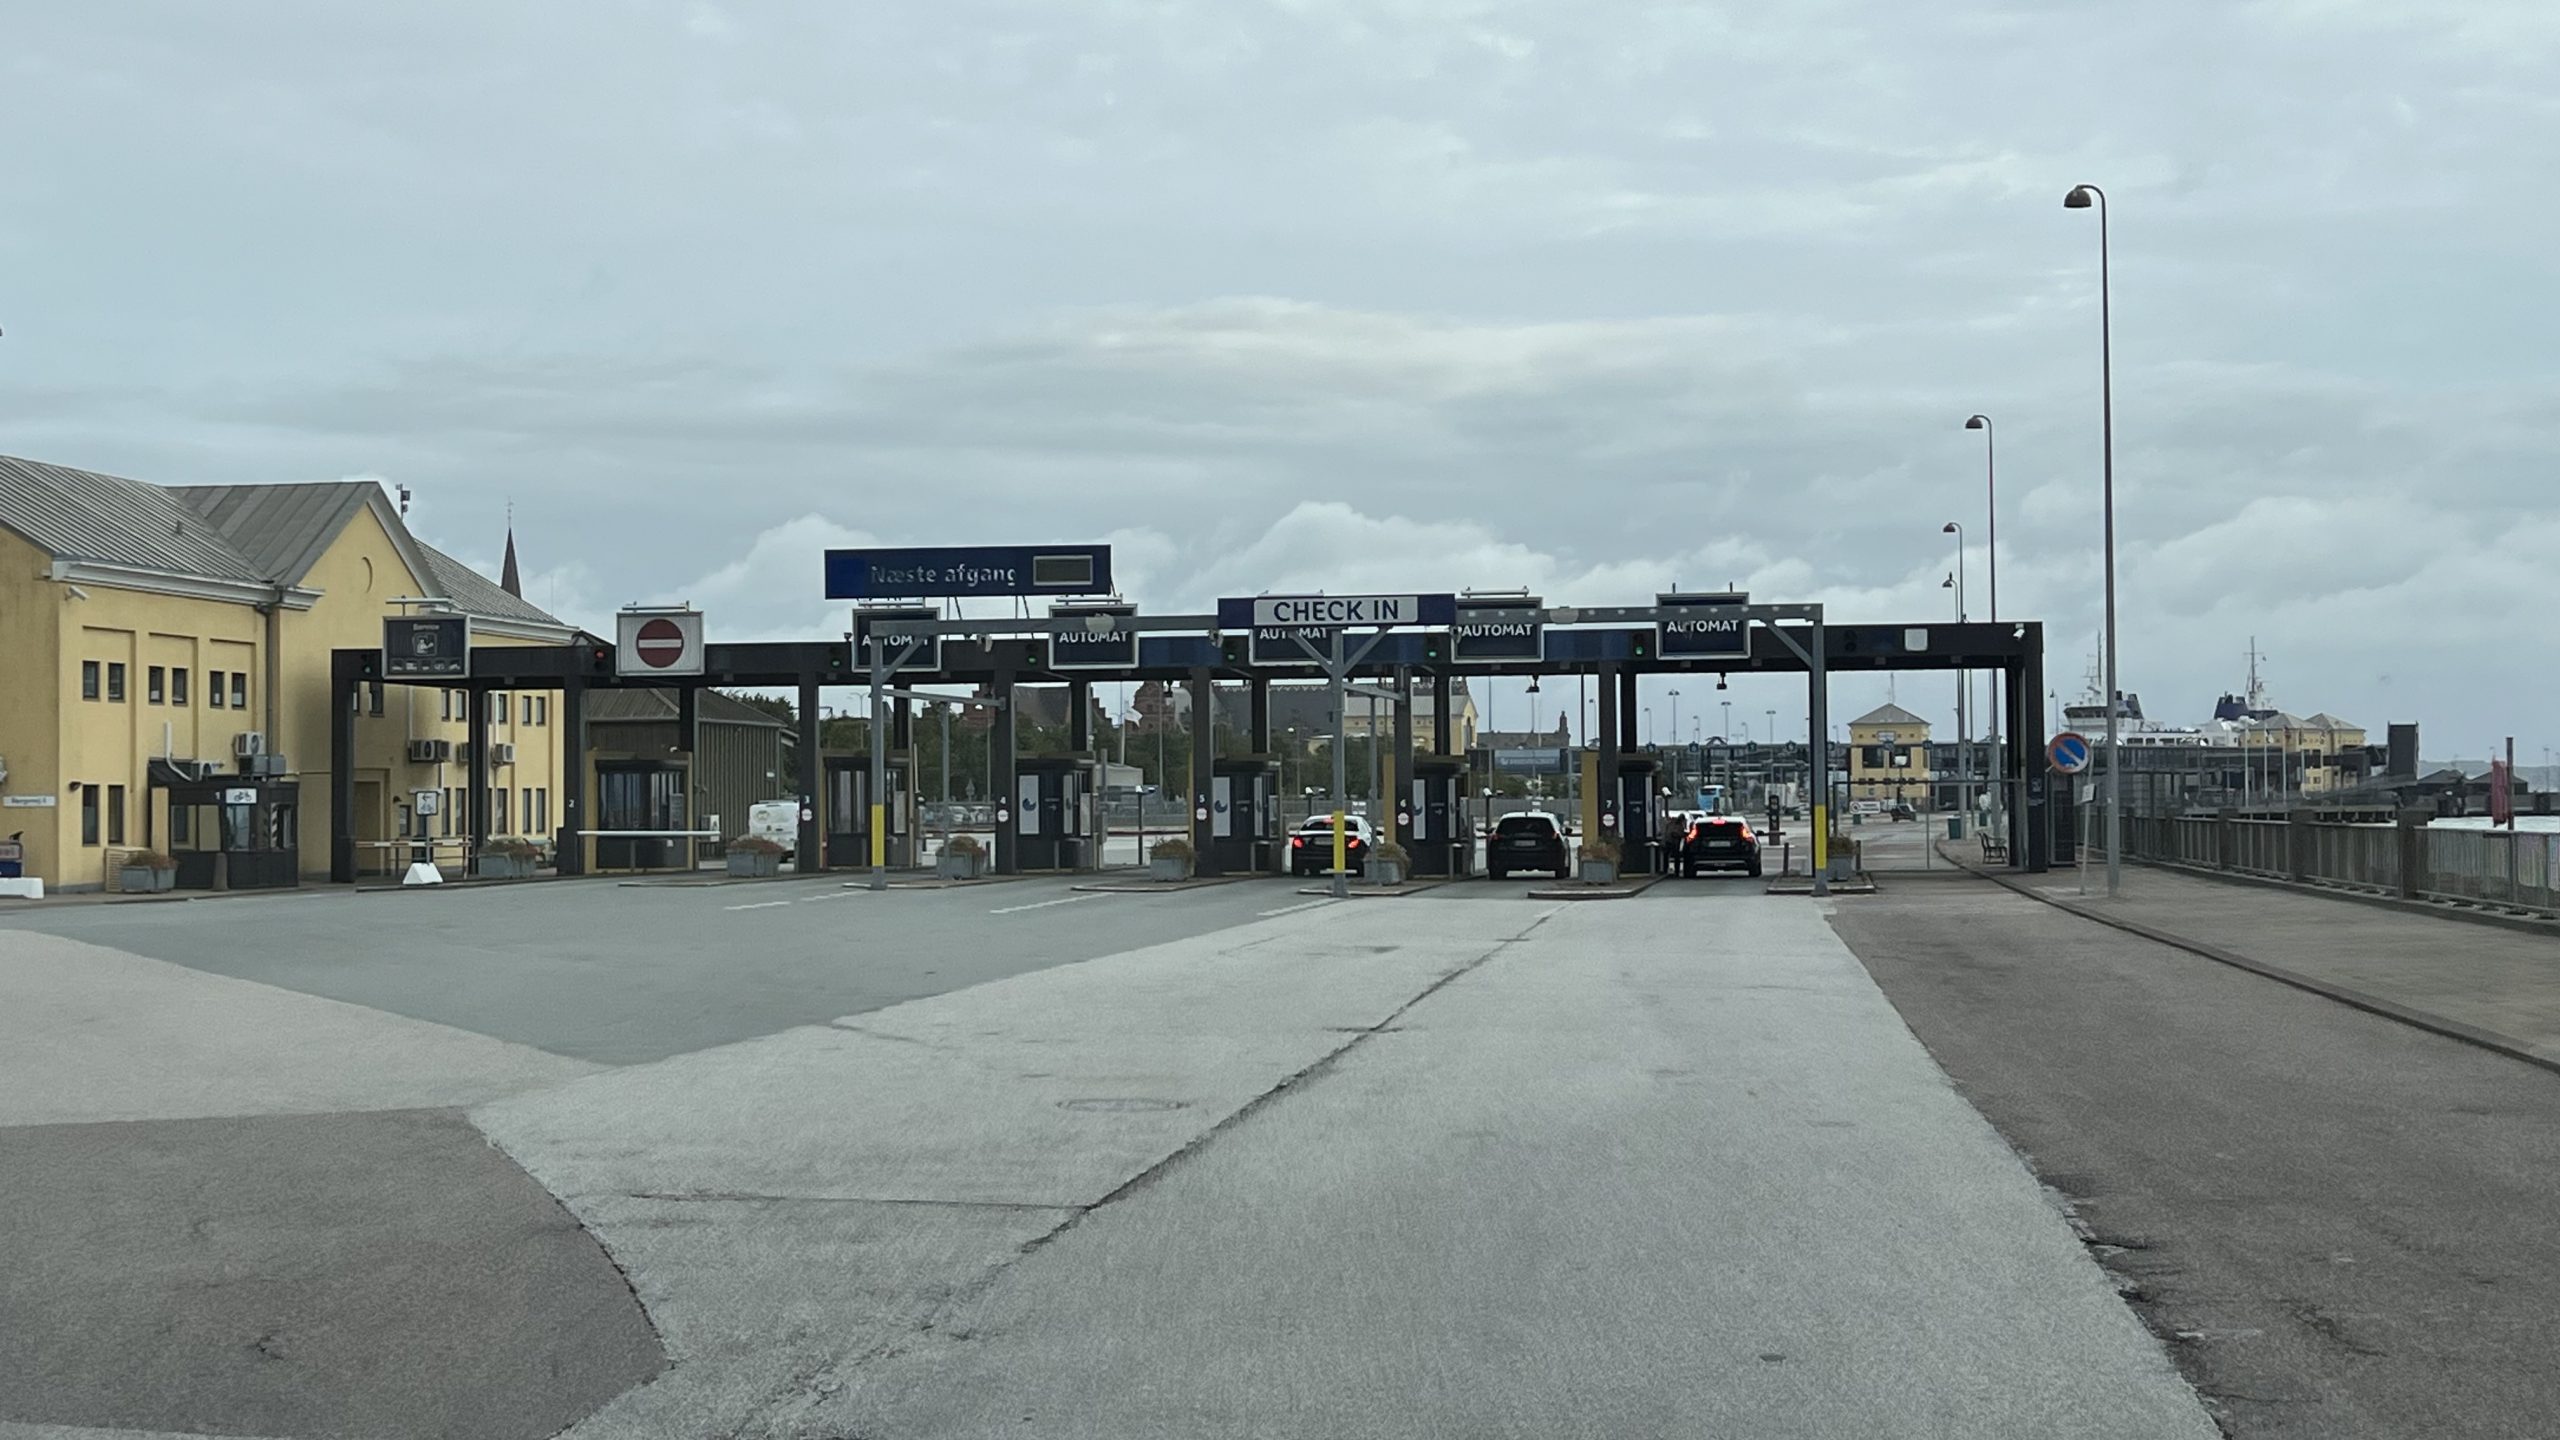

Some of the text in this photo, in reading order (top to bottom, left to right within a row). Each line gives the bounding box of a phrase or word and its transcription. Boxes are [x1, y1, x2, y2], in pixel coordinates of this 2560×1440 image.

[944, 563, 1016, 587] afgang
[1273, 600, 1399, 622] CHECK IN
[1461, 623, 1534, 637] AUTOMAT
[1667, 619, 1739, 633] AUTOMAT
[1059, 631, 1129, 643] AUTOMAT
[1259, 627, 1328, 640] AUTMAT
[568, 799, 575, 808] 2
[1199, 794, 1205, 803] 5
[1606, 800, 1613, 808] 7
